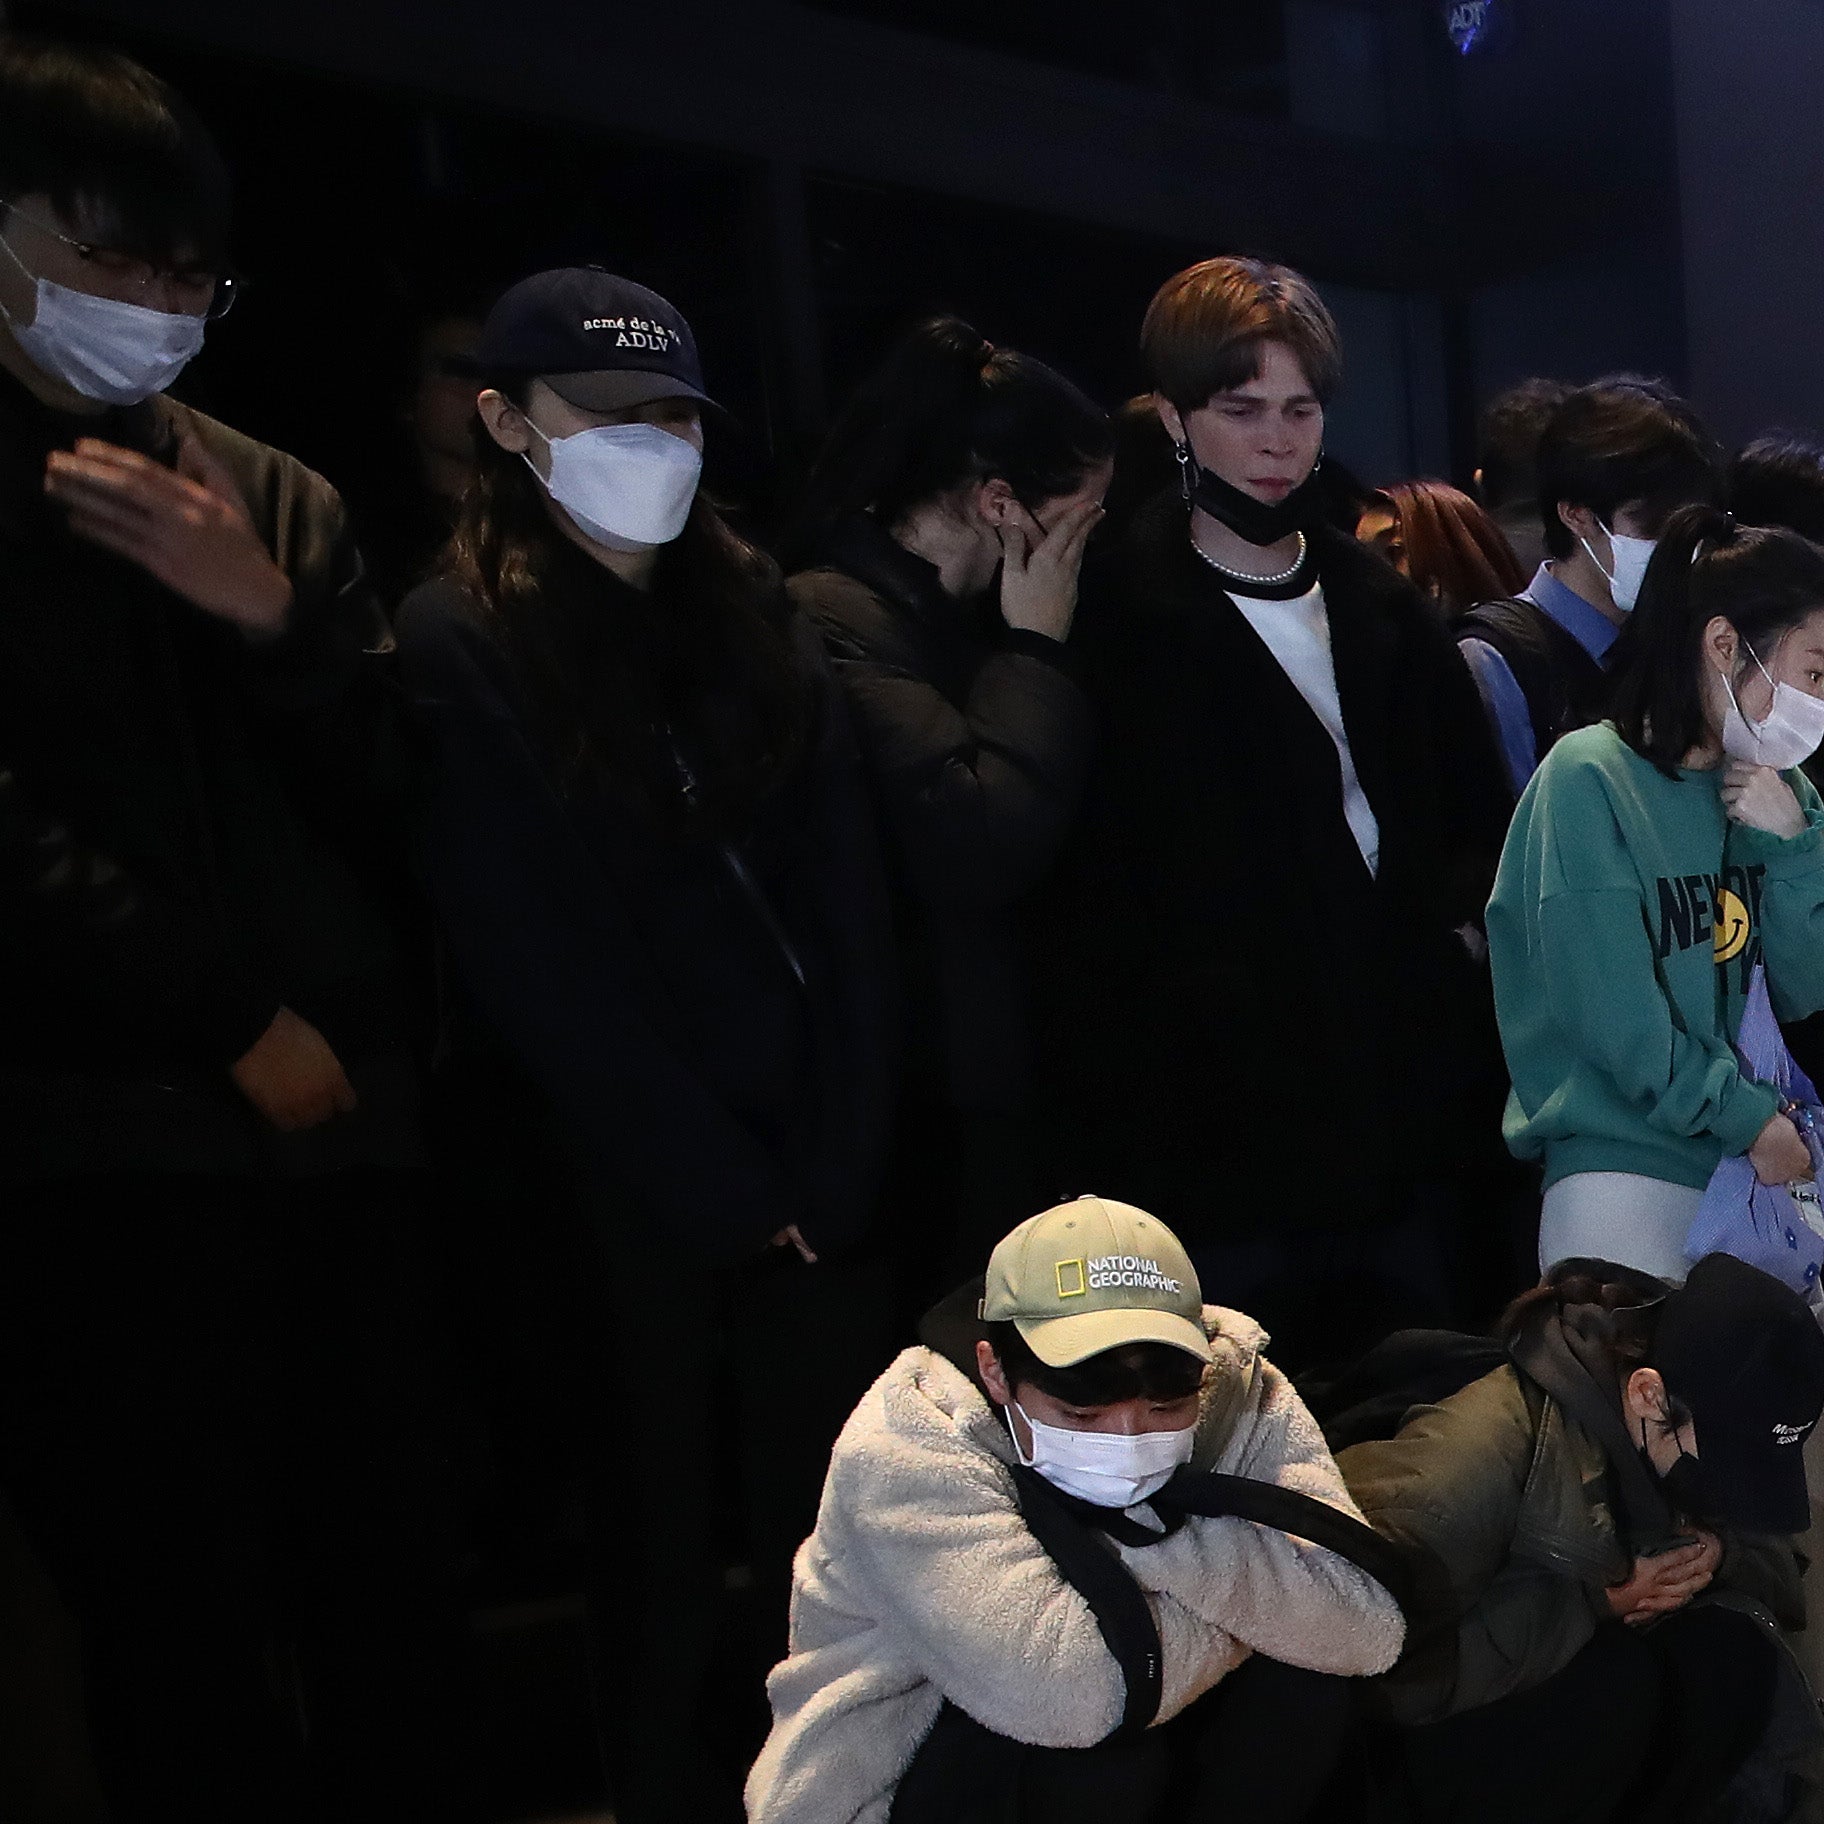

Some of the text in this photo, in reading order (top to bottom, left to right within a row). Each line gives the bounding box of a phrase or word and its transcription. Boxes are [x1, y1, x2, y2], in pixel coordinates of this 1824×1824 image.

[583, 317, 626, 331] acmé
[629, 316, 649, 331] de
[651, 320, 665, 336] la
[615, 331, 669, 352] ADLV
[1087, 1255, 1162, 1276] NATIONAL
[1088, 1271, 1180, 1295] GEOGRAPHIC
